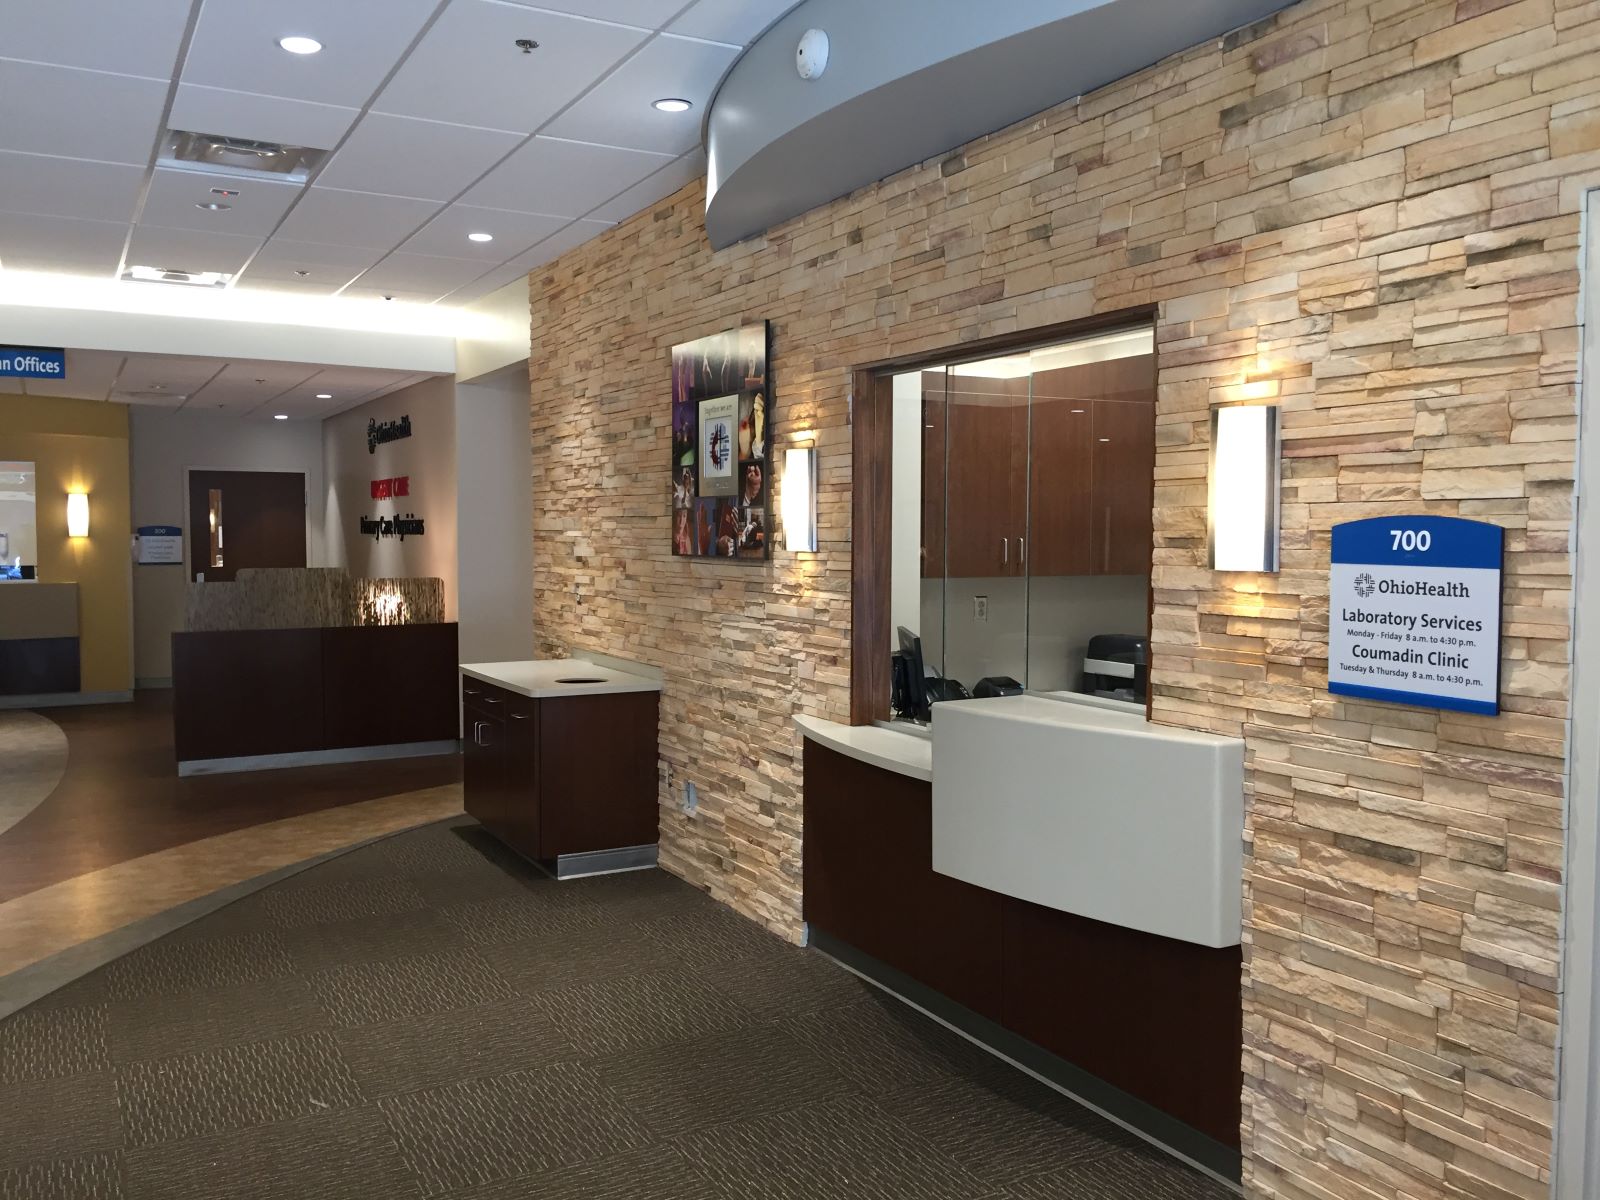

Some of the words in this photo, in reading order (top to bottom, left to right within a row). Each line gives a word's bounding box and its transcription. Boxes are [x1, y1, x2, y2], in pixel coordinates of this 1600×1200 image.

[0, 359, 11, 371] n
[14, 356, 60, 373] Offices
[1390, 530, 1431, 551] 700
[1378, 579, 1470, 598] OhioHealth
[1342, 608, 1417, 631] Laboratory
[1421, 613, 1483, 632] Services
[1347, 628, 1375, 640] Monday
[1380, 631, 1403, 642] Friday
[1405, 633, 1411, 642] 8
[1412, 635, 1428, 643] a.m.
[1430, 636, 1438, 644] to
[1439, 637, 1457, 646] 4:30
[1458, 639, 1476, 648] p.m.
[1352, 644, 1423, 664] Coumadin
[1427, 651, 1469, 669] Clinic
[1340, 662, 1367, 675] Tuesday
[1368, 666, 1375, 674] &
[1376, 667, 1409, 679] Thursday
[1412, 671, 1417, 680] 8
[1419, 673, 1435, 681] a.m.
[1436, 674, 1445, 682] to
[1446, 675, 1464, 685] 4:30
[1465, 677, 1483, 687] p.m.
